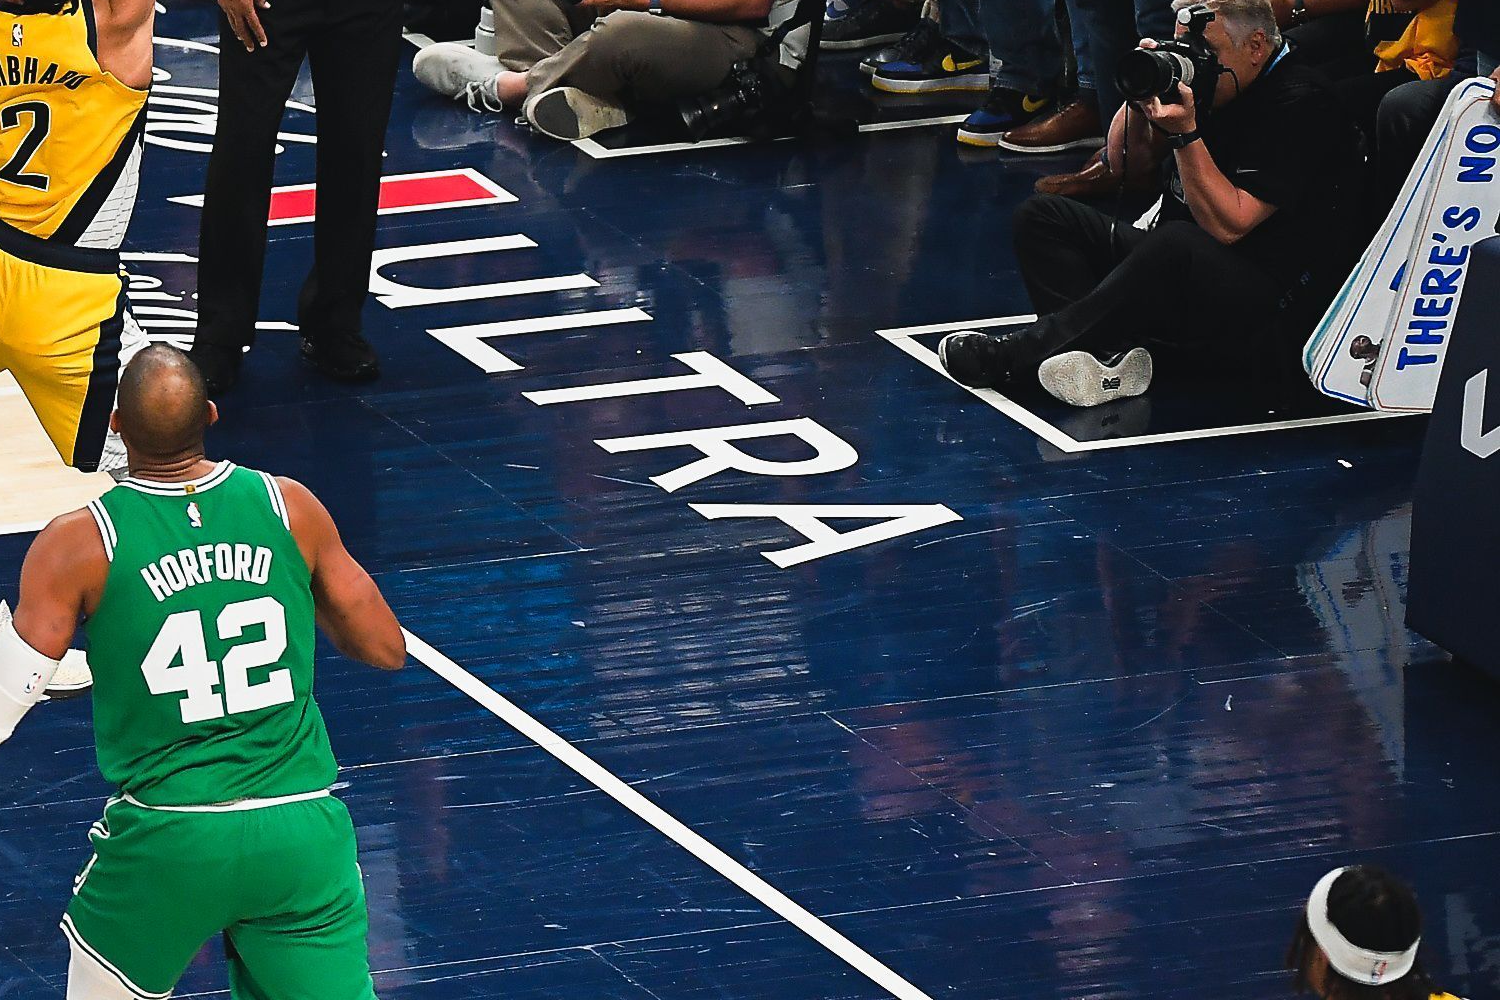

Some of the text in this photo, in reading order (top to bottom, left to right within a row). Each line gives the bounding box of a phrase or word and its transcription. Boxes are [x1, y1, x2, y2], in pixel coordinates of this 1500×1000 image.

[1396, 205, 1481, 371] THERE'S
[1456, 124, 1500, 183] NO
[367, 232, 964, 571] ULTRA
[139, 542, 274, 603] HORFORD
[140, 596, 296, 724] 42
